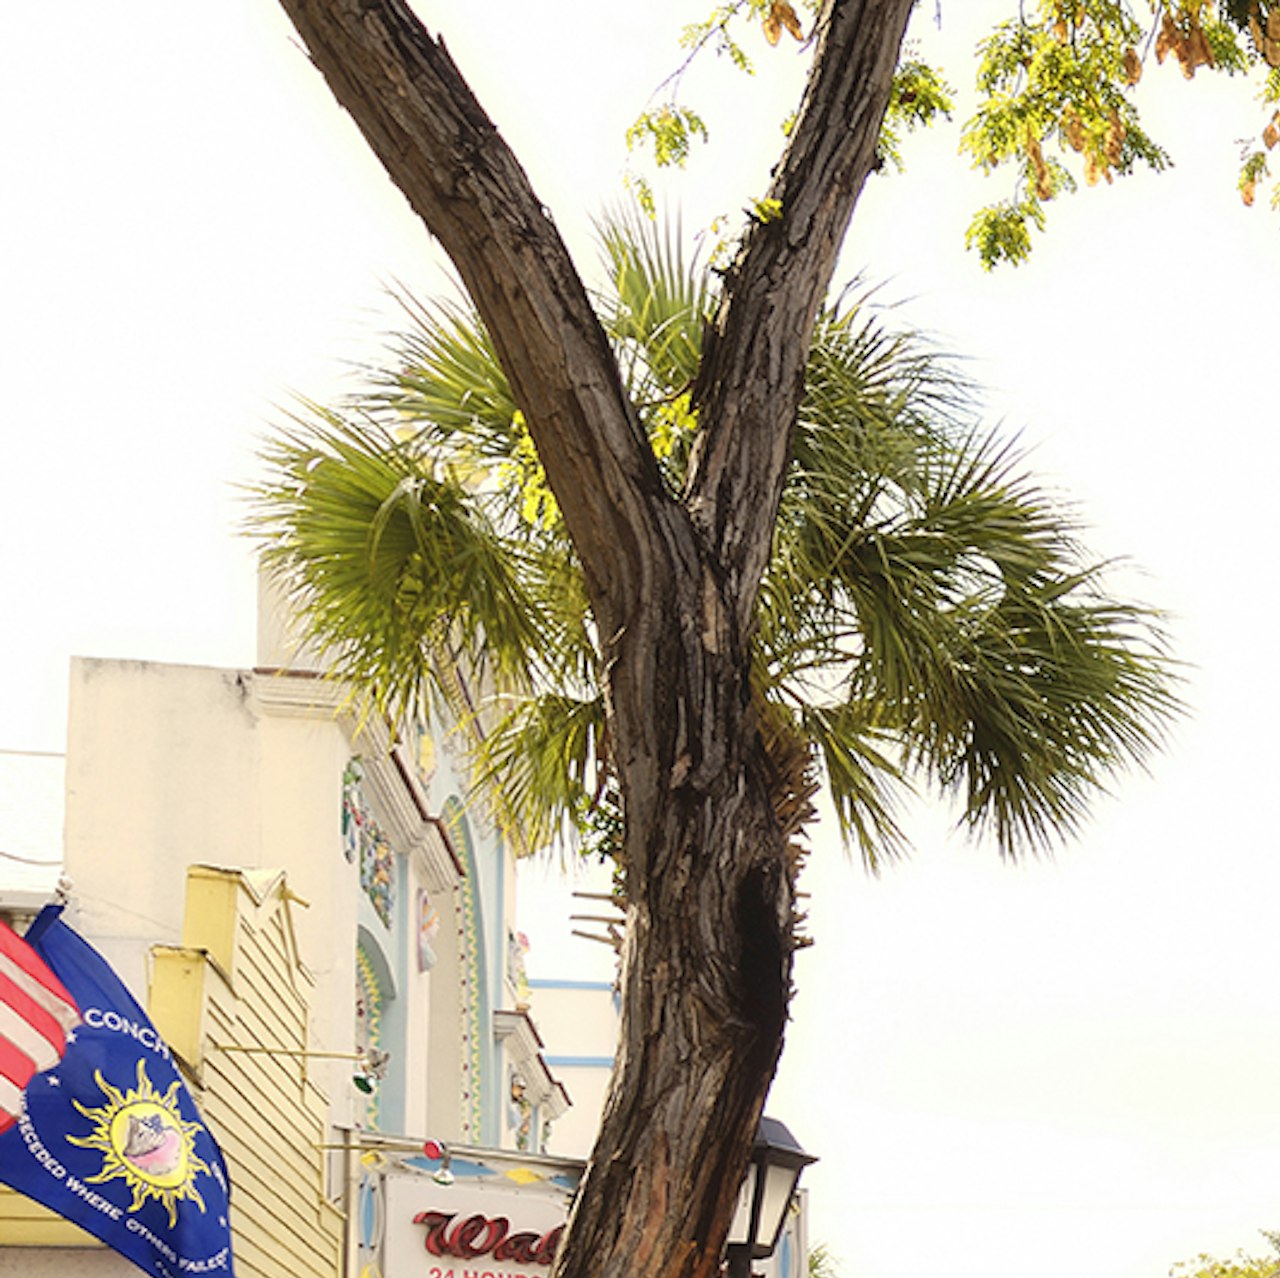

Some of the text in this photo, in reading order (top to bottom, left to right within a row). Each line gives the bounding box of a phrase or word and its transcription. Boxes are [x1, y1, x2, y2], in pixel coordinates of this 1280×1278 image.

[84, 1008, 170, 1060] CONCH
[66, 1176, 124, 1221] WHERE
[125, 1218, 177, 1264] OTHERS
